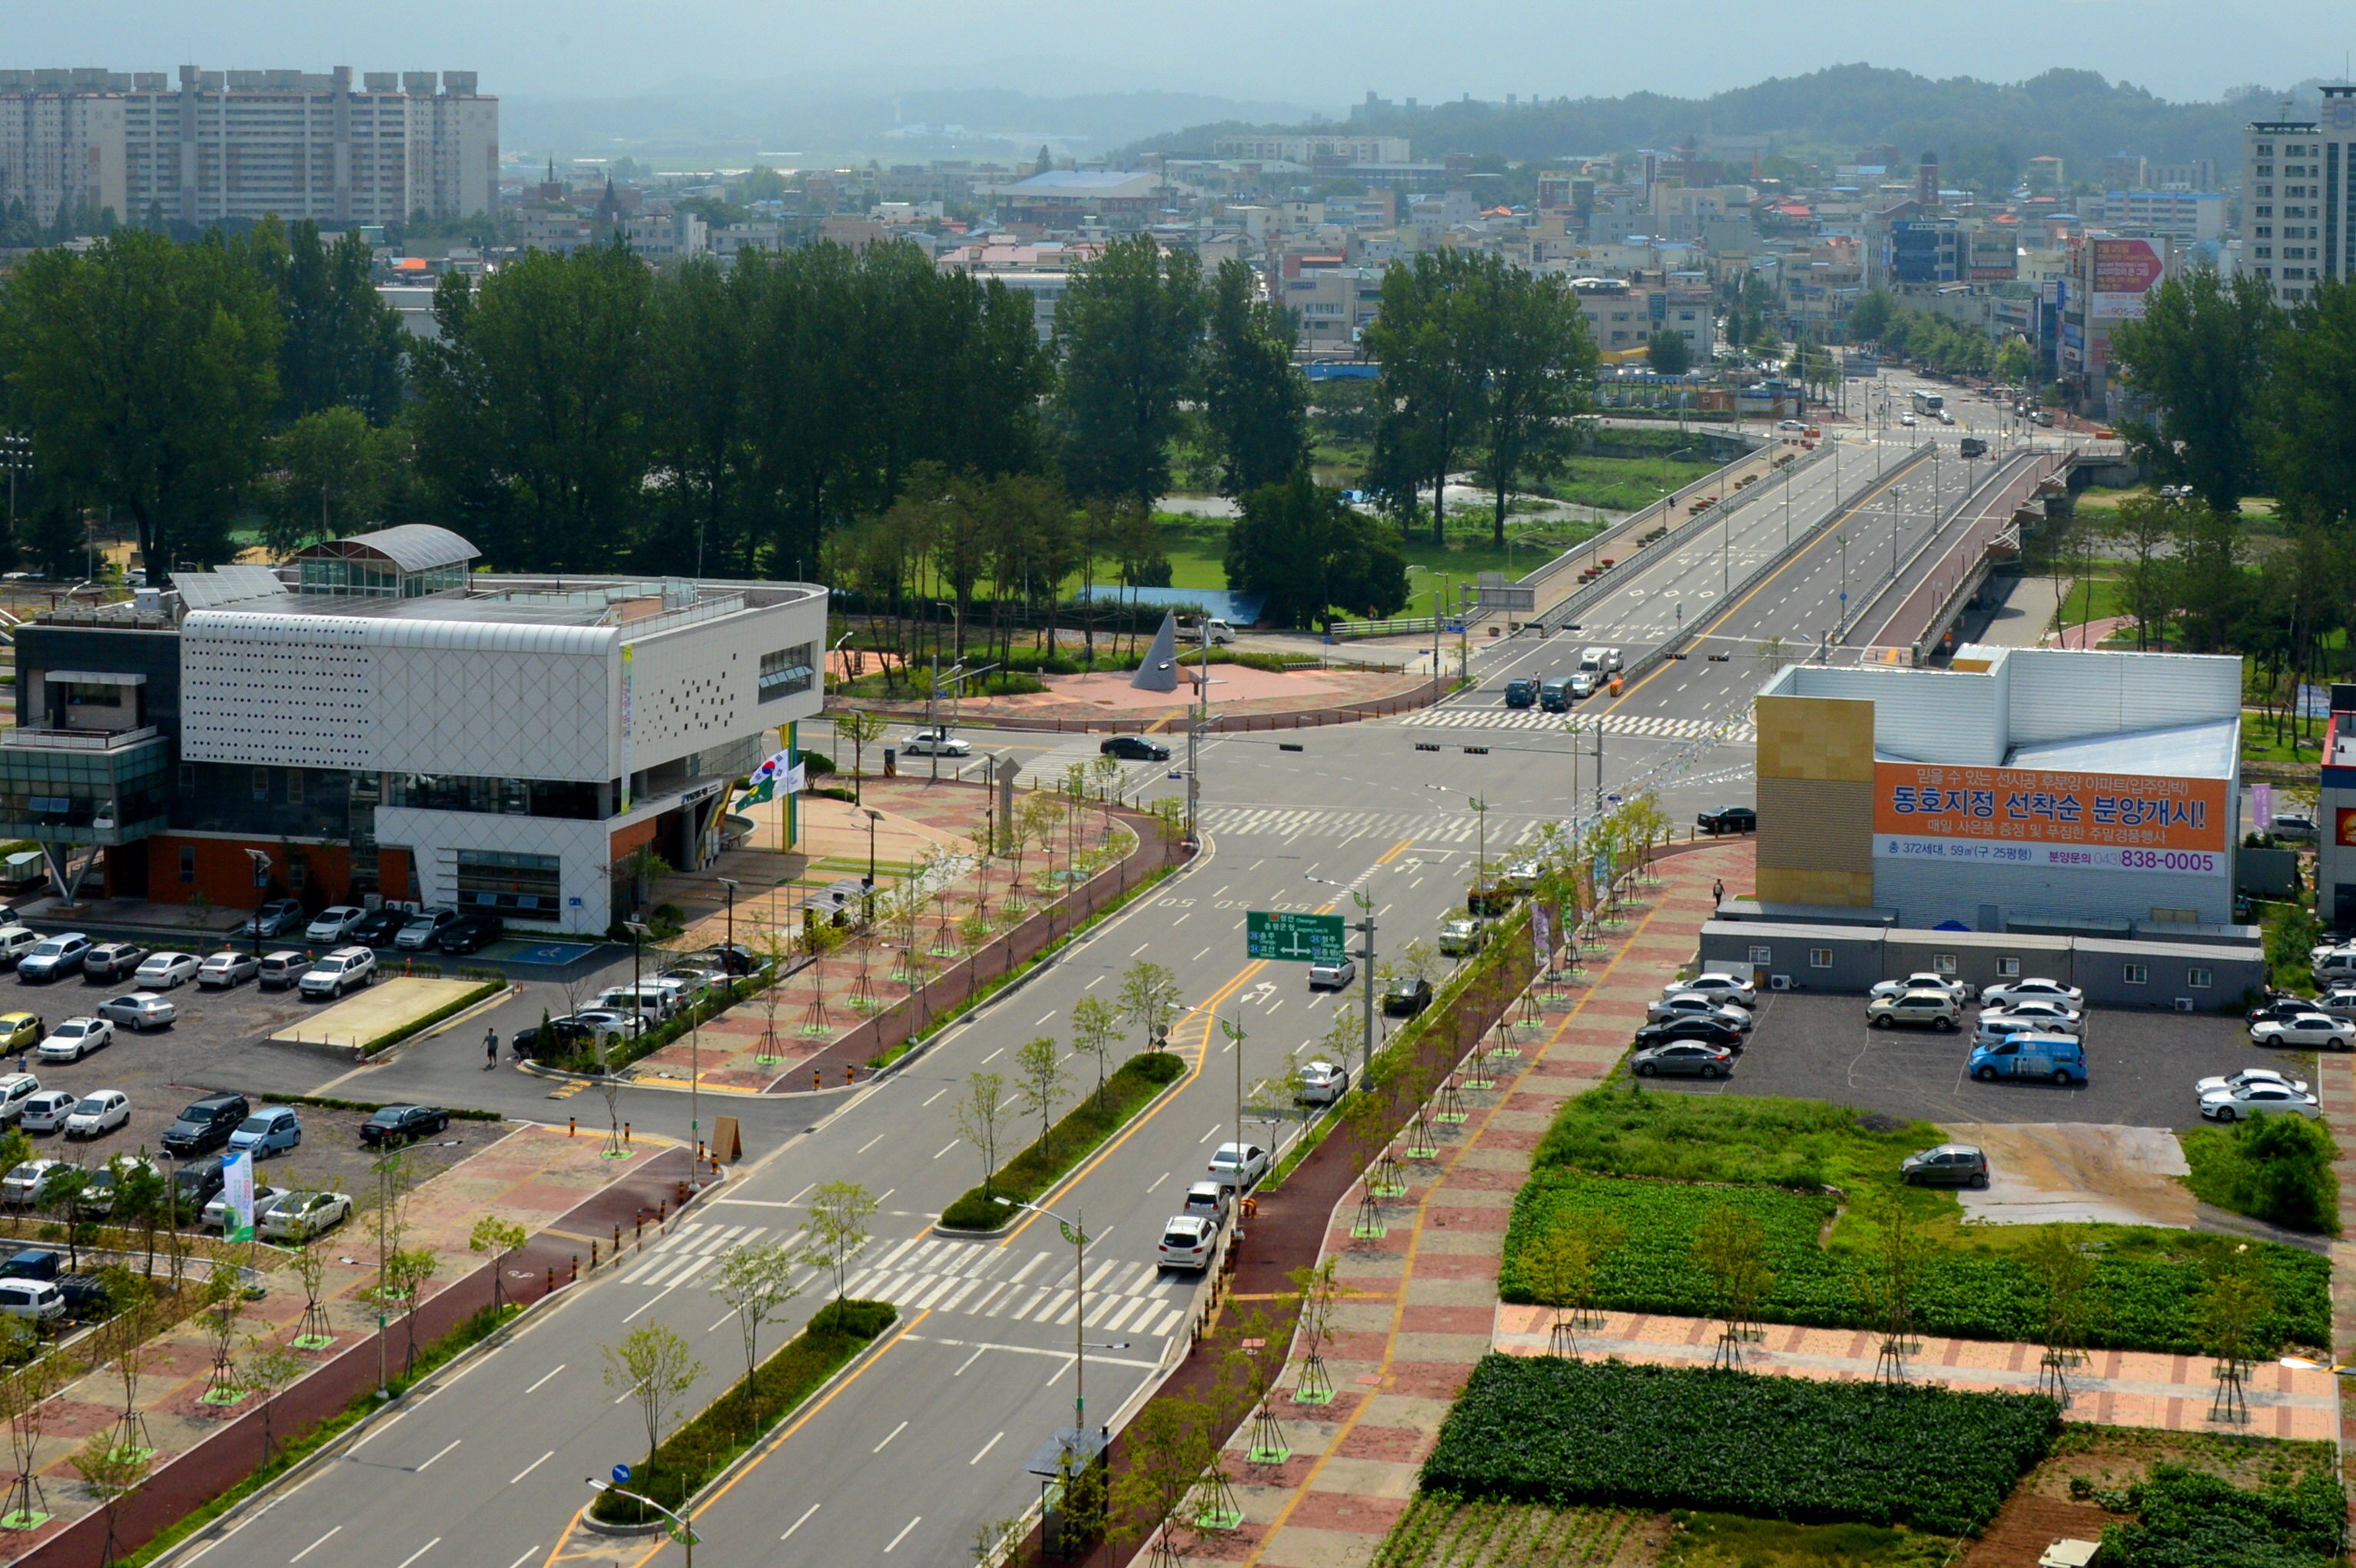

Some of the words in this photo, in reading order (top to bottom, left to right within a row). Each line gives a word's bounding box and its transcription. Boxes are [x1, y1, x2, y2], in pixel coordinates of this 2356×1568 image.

[1916, 767, 1943, 785] 믿을
[1947, 770, 1960, 786] 수
[1965, 770, 1993, 787] 있는
[1996, 771, 2036, 790] 선시공
[2040, 774, 2082, 792] 후분양
[2085, 776, 2189, 797] 아파트(입주임박)
[1892, 785, 1996, 819] 동호지정
[2004, 790, 2082, 822] 선착순
[2091, 794, 2206, 830] 분양개시!
[1927, 819, 1953, 834] 매일
[1956, 820, 1996, 836] 사은품
[1999, 823, 2026, 837] 증정
[2029, 824, 2042, 839] 및
[2046, 824, 2086, 840] 푸짐한
[2089, 827, 2167, 844] 주말경품행사
[1888, 840, 1900, 854] 총
[1993, 847, 2032, 861] 25평형)
[2048, 850, 2092, 865] 분양문의
